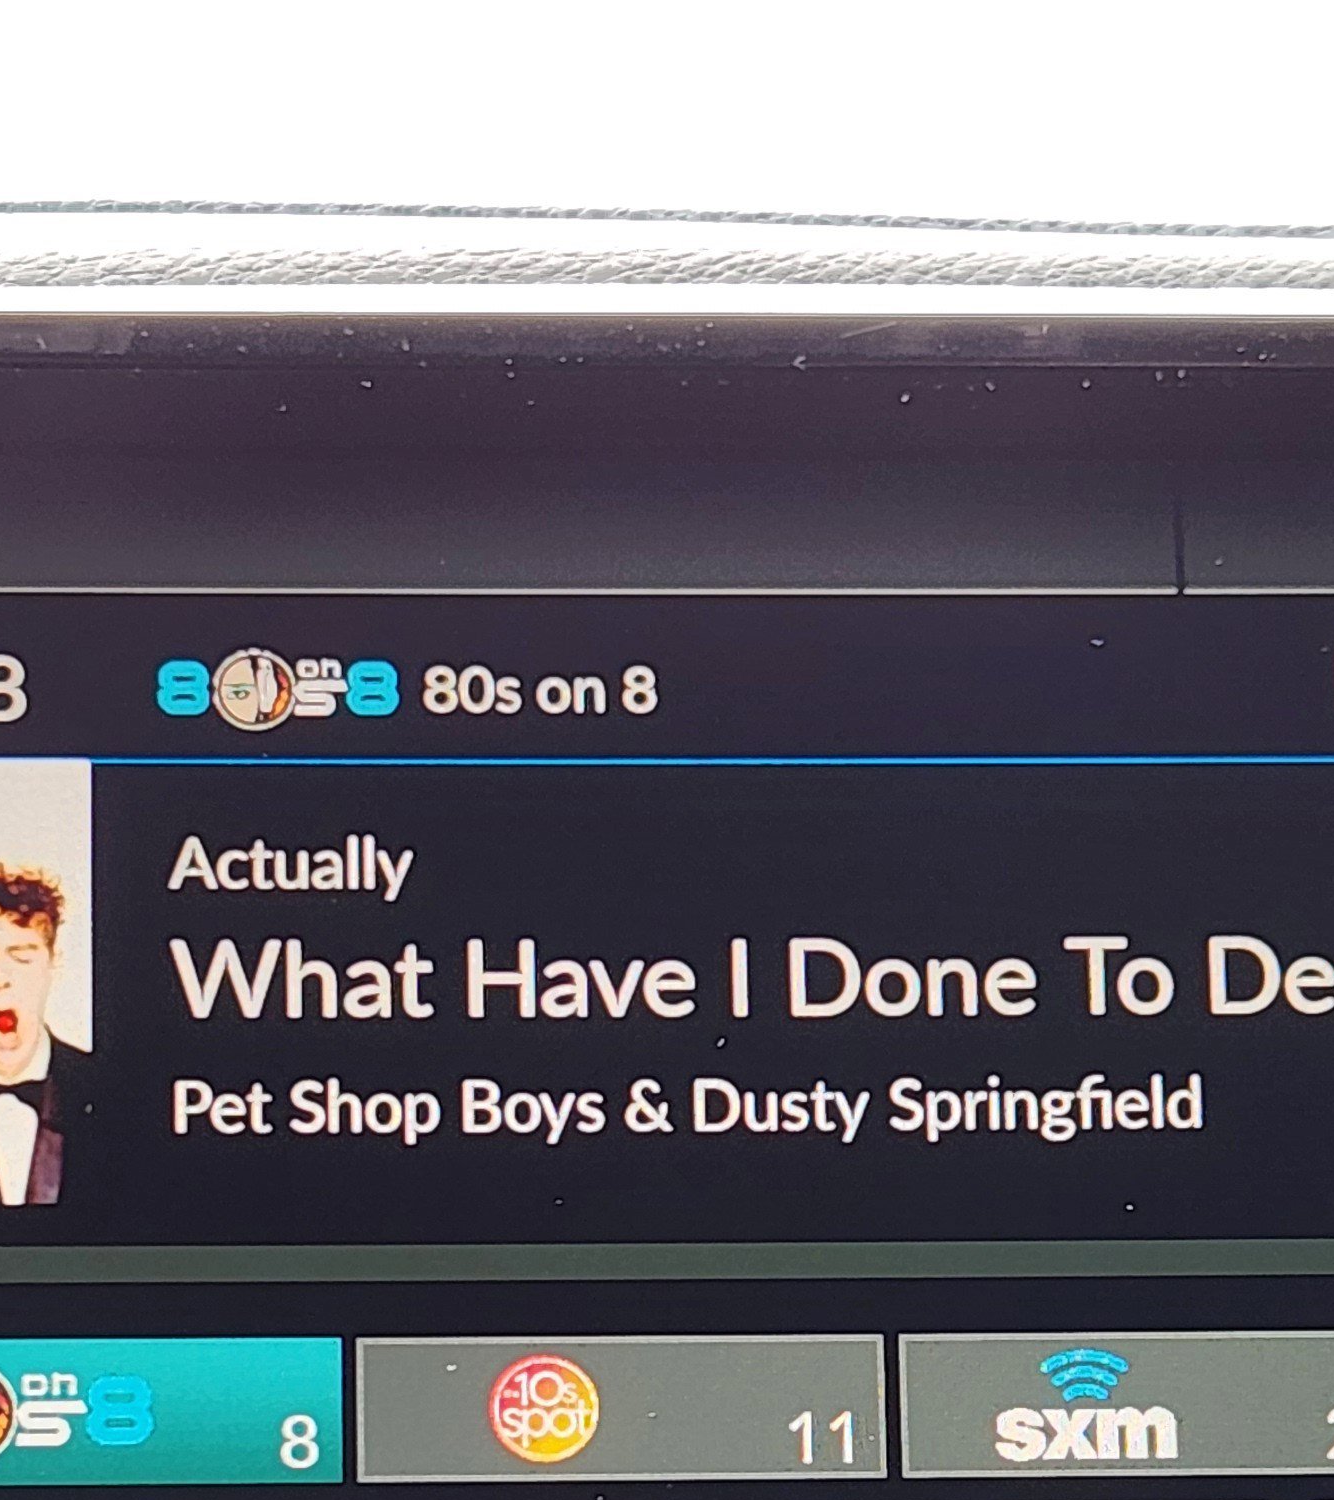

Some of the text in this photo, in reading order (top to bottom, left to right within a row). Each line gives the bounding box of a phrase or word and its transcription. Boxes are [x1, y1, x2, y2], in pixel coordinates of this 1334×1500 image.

[422, 665, 658, 714] 80s on 8
[167, 834, 414, 902] Actually
[169, 938, 435, 1019] What
[467, 938, 696, 1018] Have
[731, 938, 749, 1018] I
[788, 937, 1037, 1018] Done
[1063, 936, 1175, 1016] To
[173, 1073, 1203, 1146] Pet Shop Boys & Dusty Springfield
[280, 1414, 320, 1469] 8
[503, 1399, 592, 1448] spot
[788, 1410, 854, 1465] 11
[993, 1404, 1181, 1464] sxm
